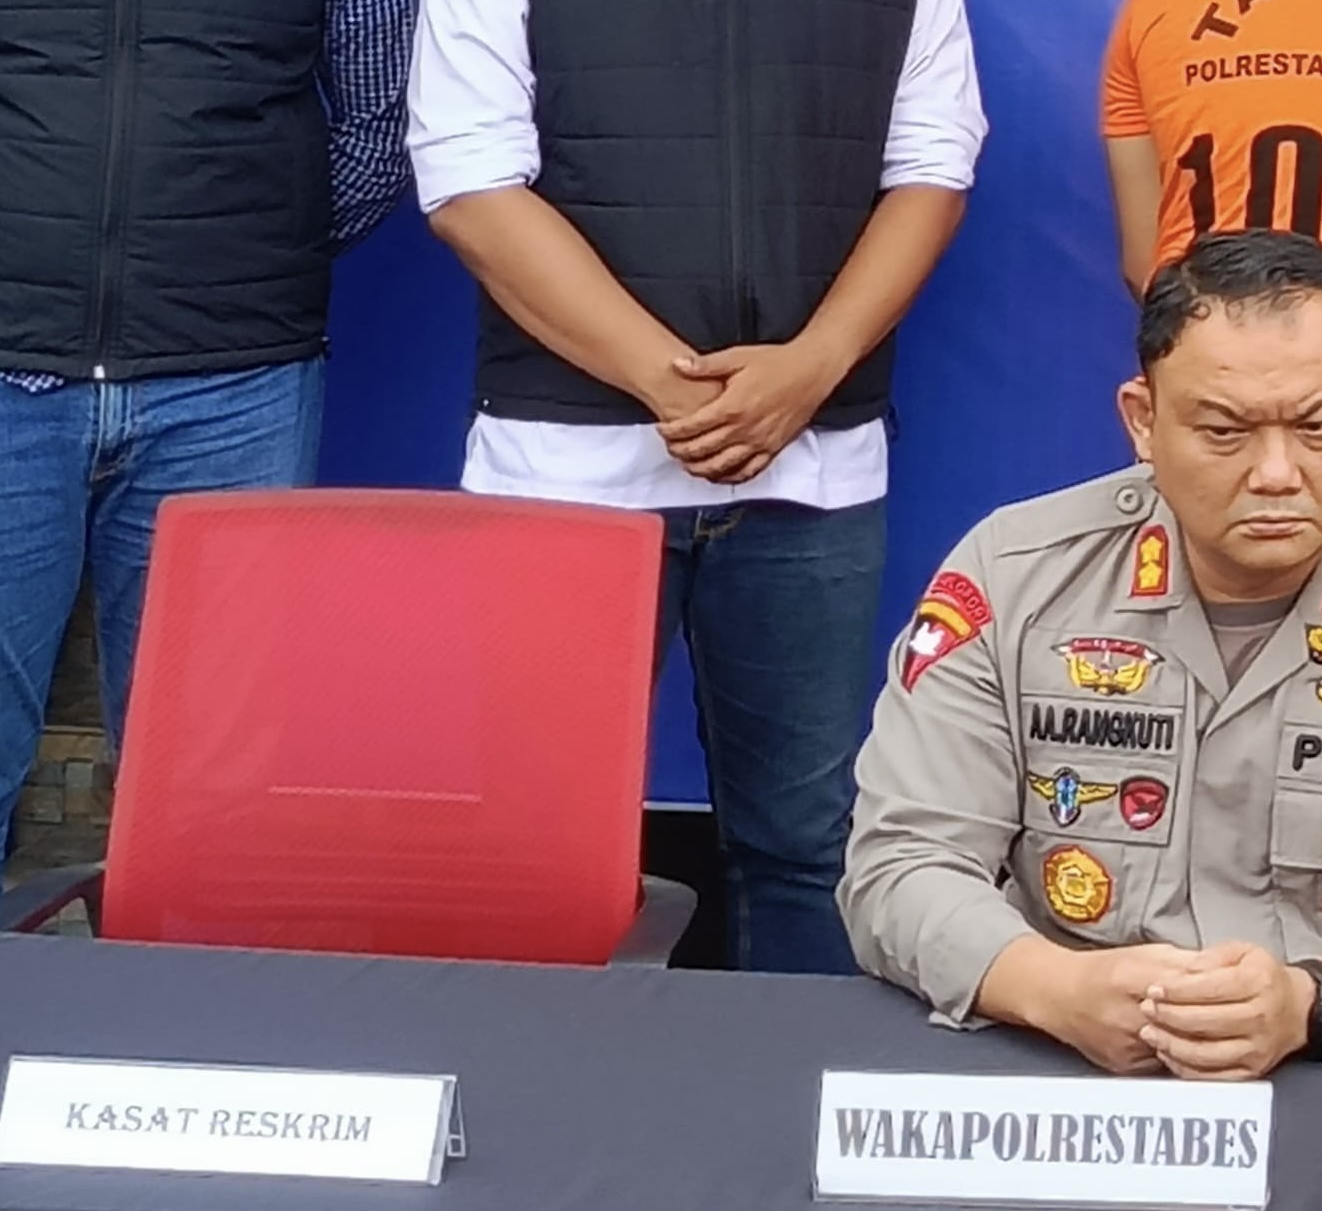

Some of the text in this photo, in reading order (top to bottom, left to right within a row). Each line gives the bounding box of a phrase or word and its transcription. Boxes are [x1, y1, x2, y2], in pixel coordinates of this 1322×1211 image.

[64, 1102, 373, 1143] KASAT RESKRIM
[834, 1107, 1259, 1170] WAKAPOLRESTABES
